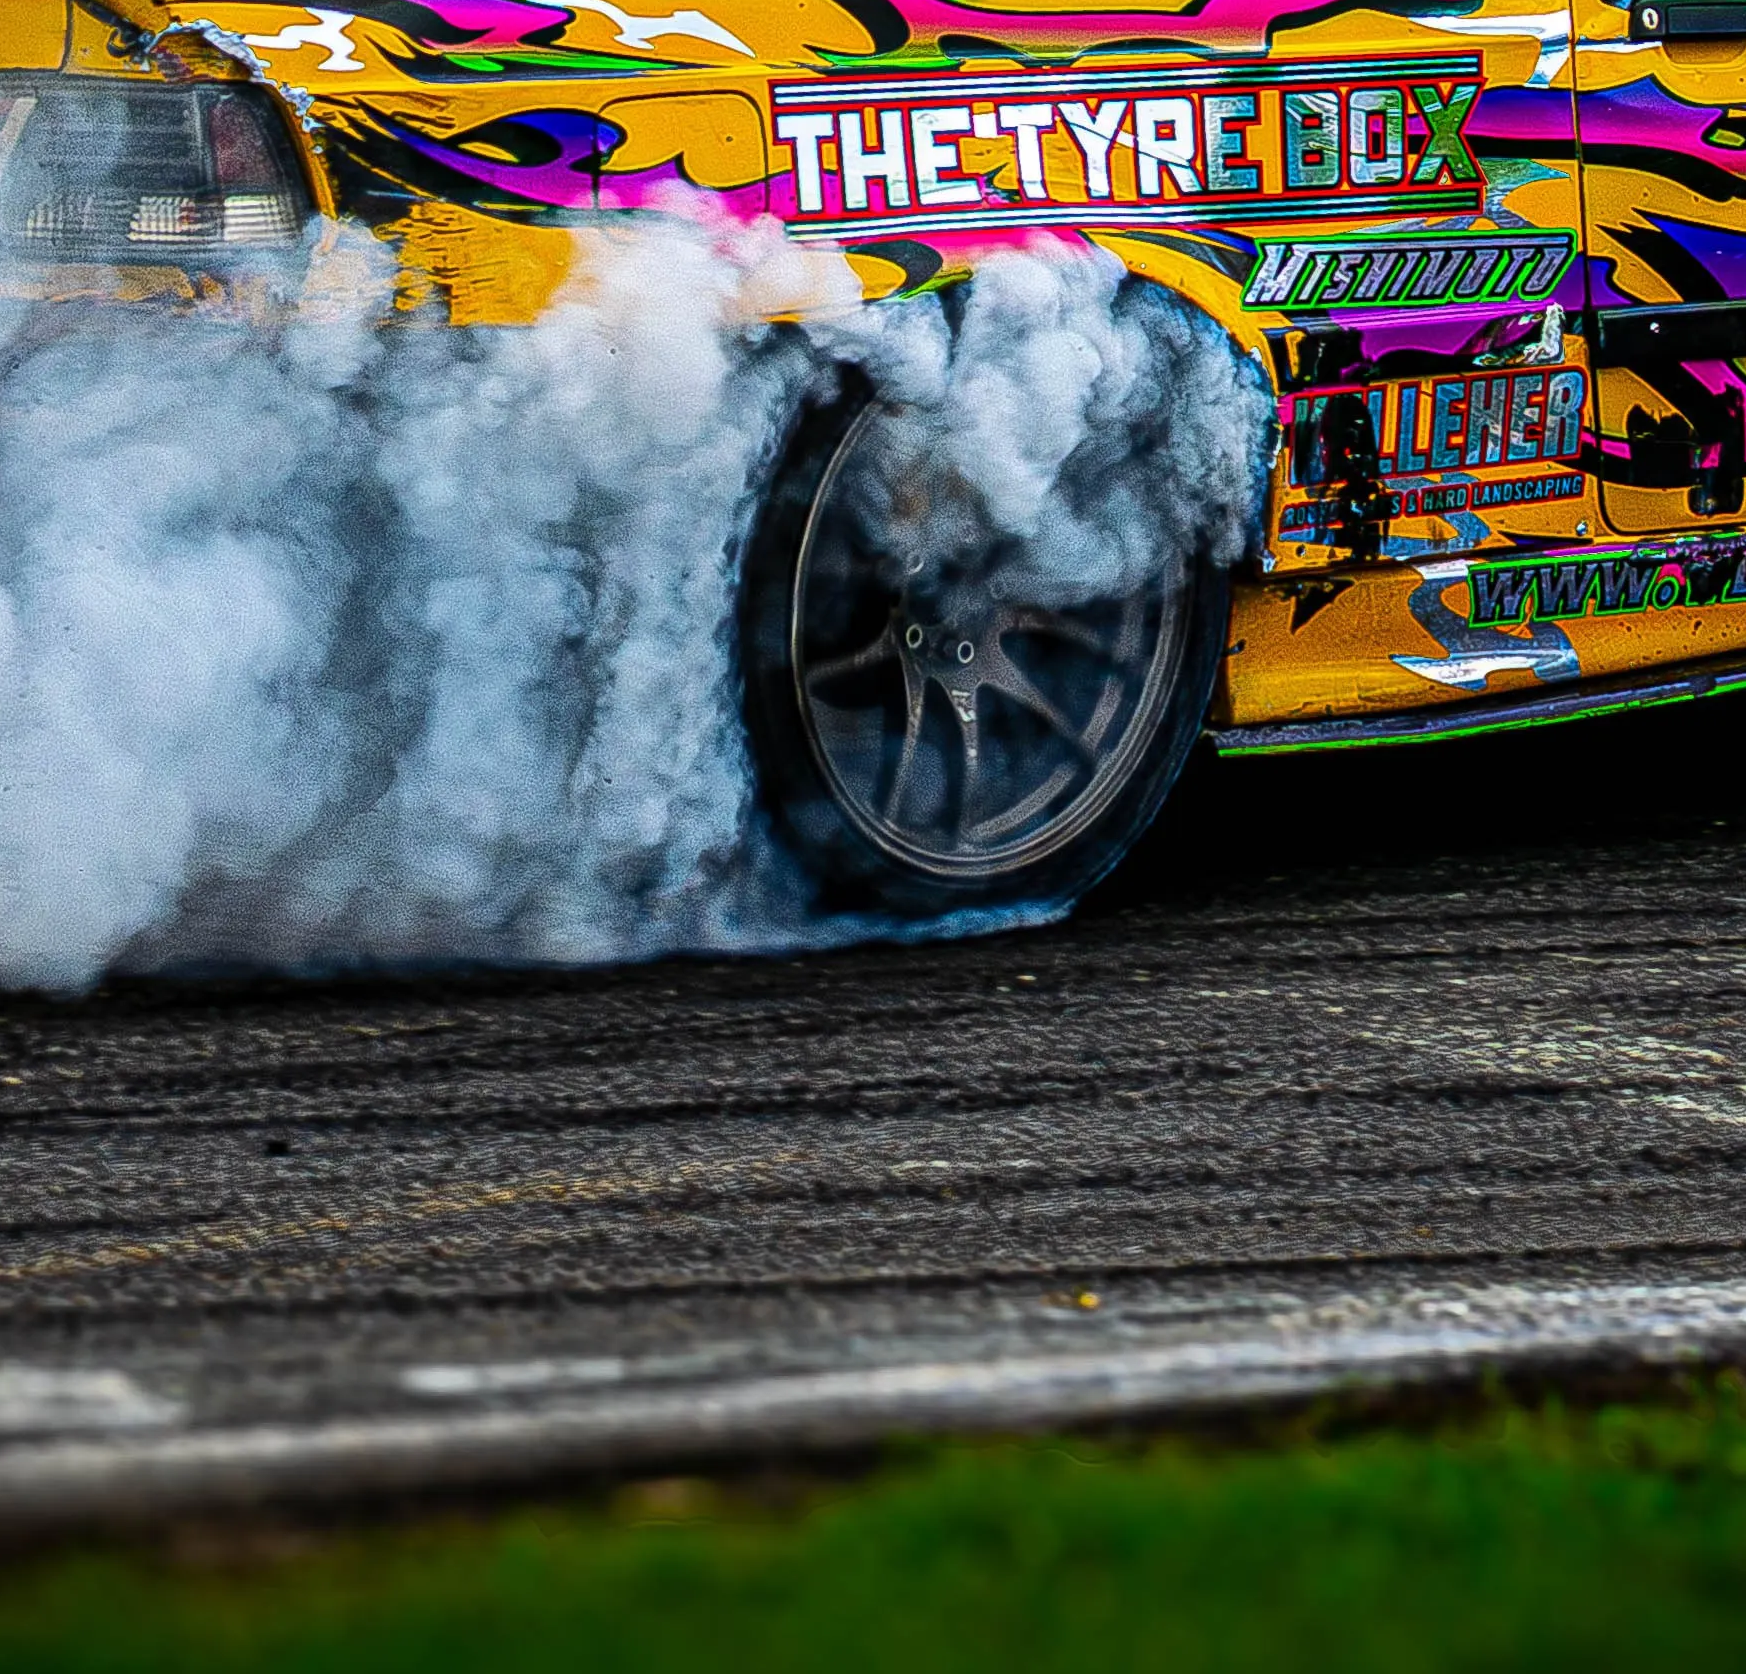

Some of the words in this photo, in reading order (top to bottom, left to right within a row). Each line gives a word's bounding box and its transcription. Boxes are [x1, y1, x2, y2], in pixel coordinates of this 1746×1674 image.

[775, 106, 983, 211] THE
[999, 95, 1259, 200] TYRE
[1284, 83, 1483, 188] BOX
[1244, 236, 1569, 302] MISHIMOTO
[1423, 489, 1466, 511] HARD
[1473, 477, 1583, 506] LANDSCAPING
